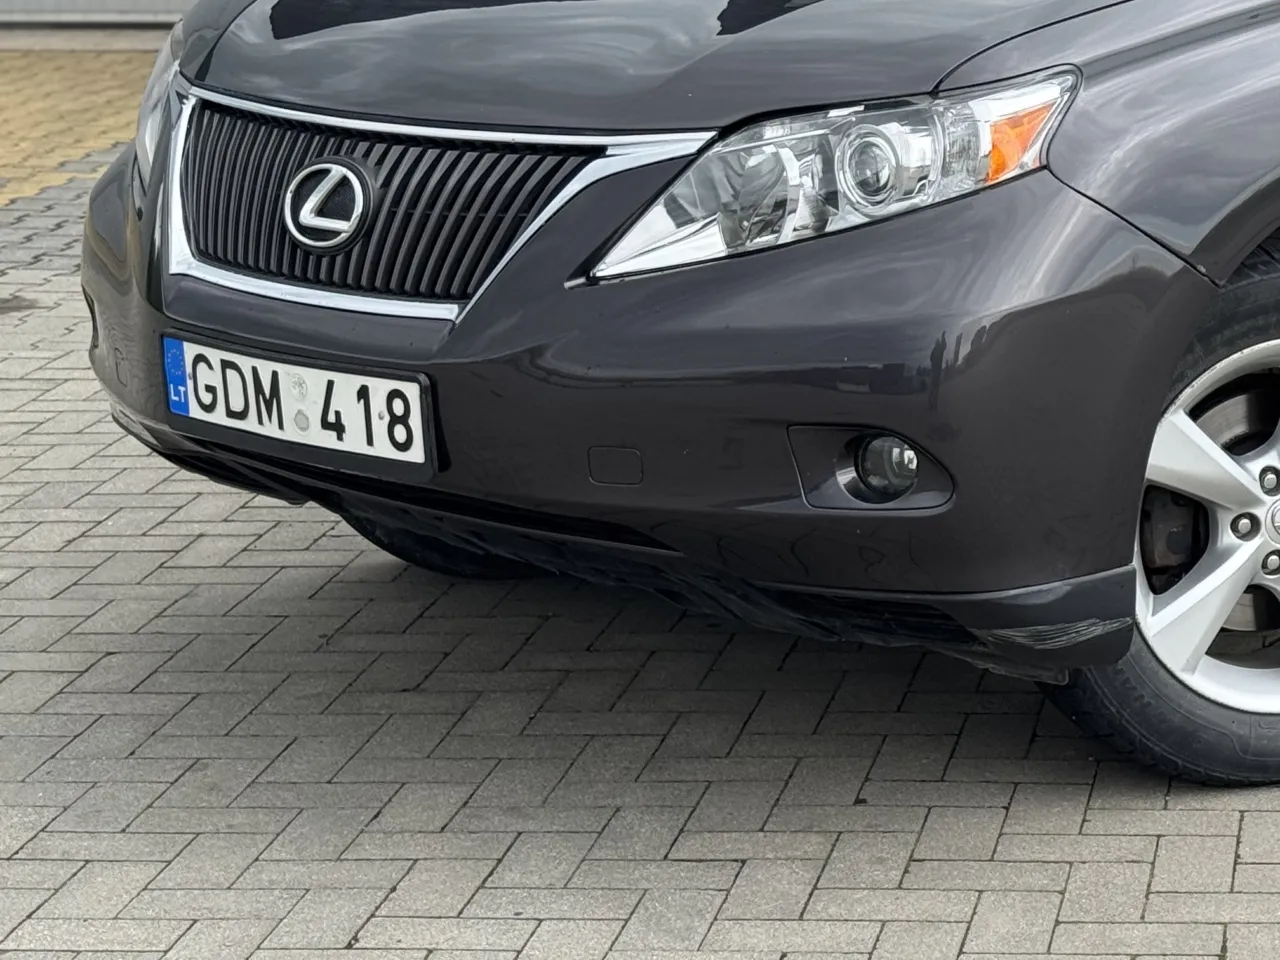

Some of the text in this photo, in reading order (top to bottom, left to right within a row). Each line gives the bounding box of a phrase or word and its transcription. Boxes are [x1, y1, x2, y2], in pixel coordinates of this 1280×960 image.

[170, 383, 186, 402] LT
[191, 352, 413, 453] GDM 418
